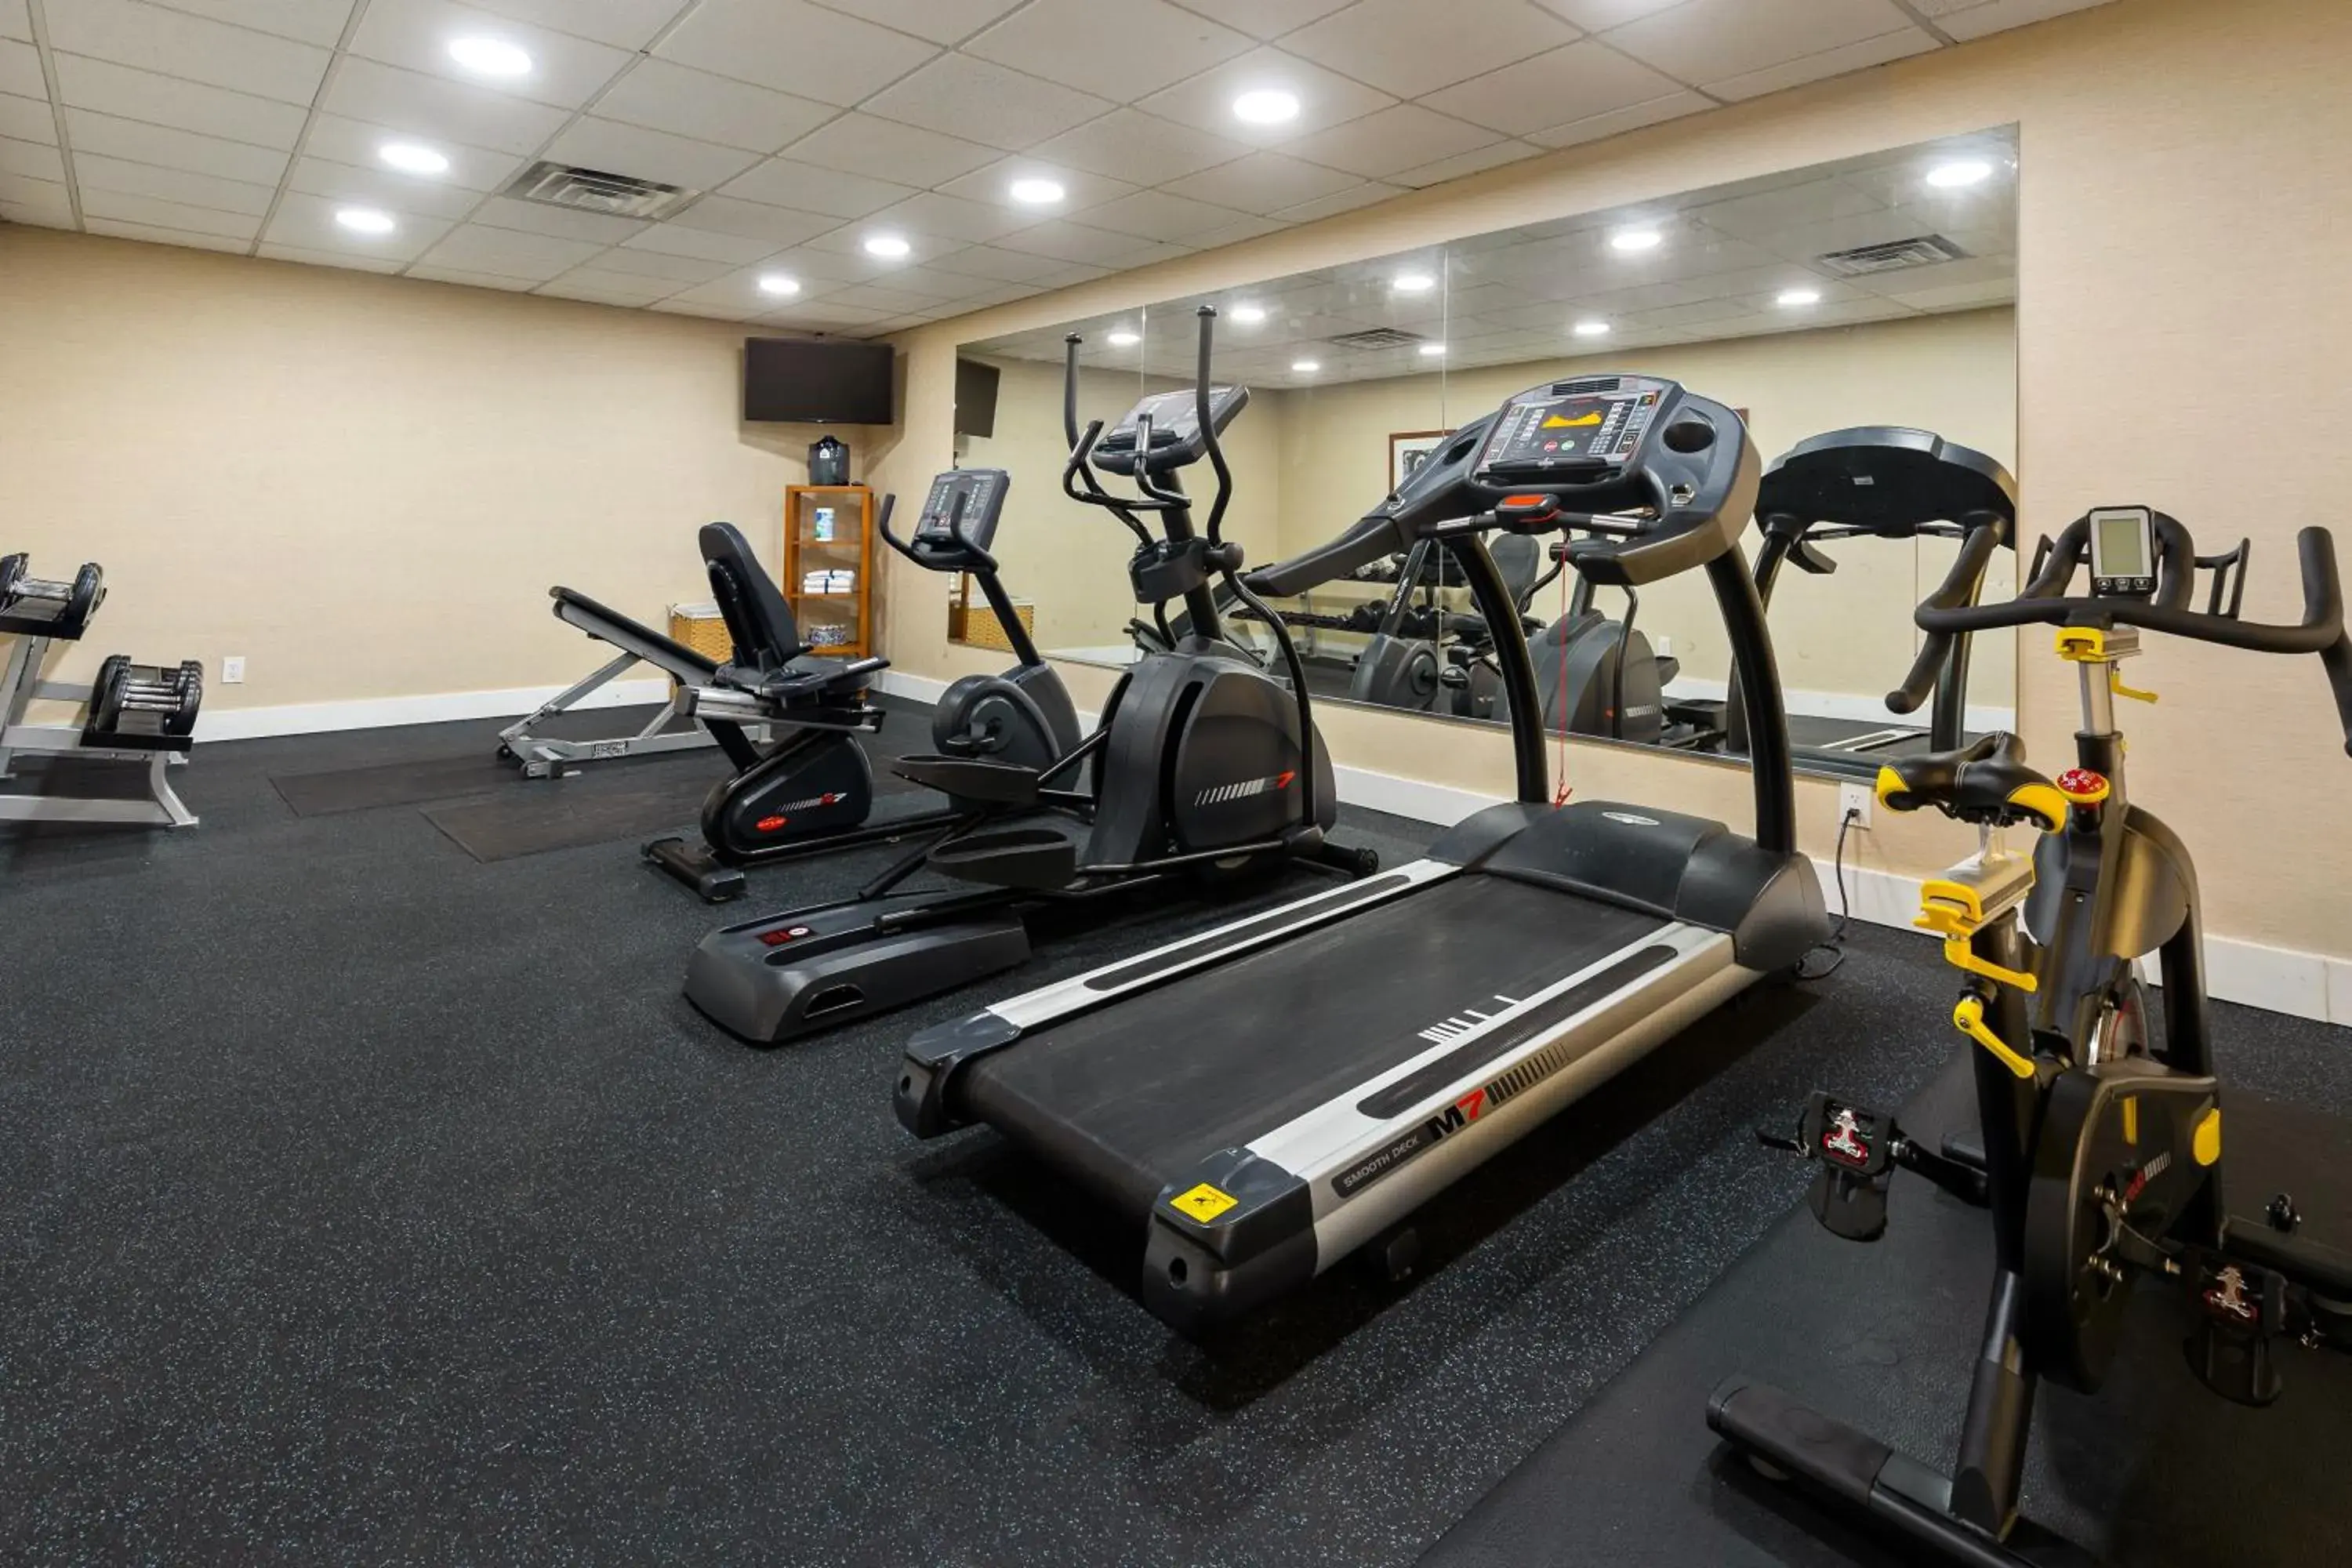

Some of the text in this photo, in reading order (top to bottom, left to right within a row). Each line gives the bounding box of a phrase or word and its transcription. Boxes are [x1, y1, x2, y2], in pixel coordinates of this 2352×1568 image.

[1343, 1087, 1486, 1188] SMOOTH DECK M7
